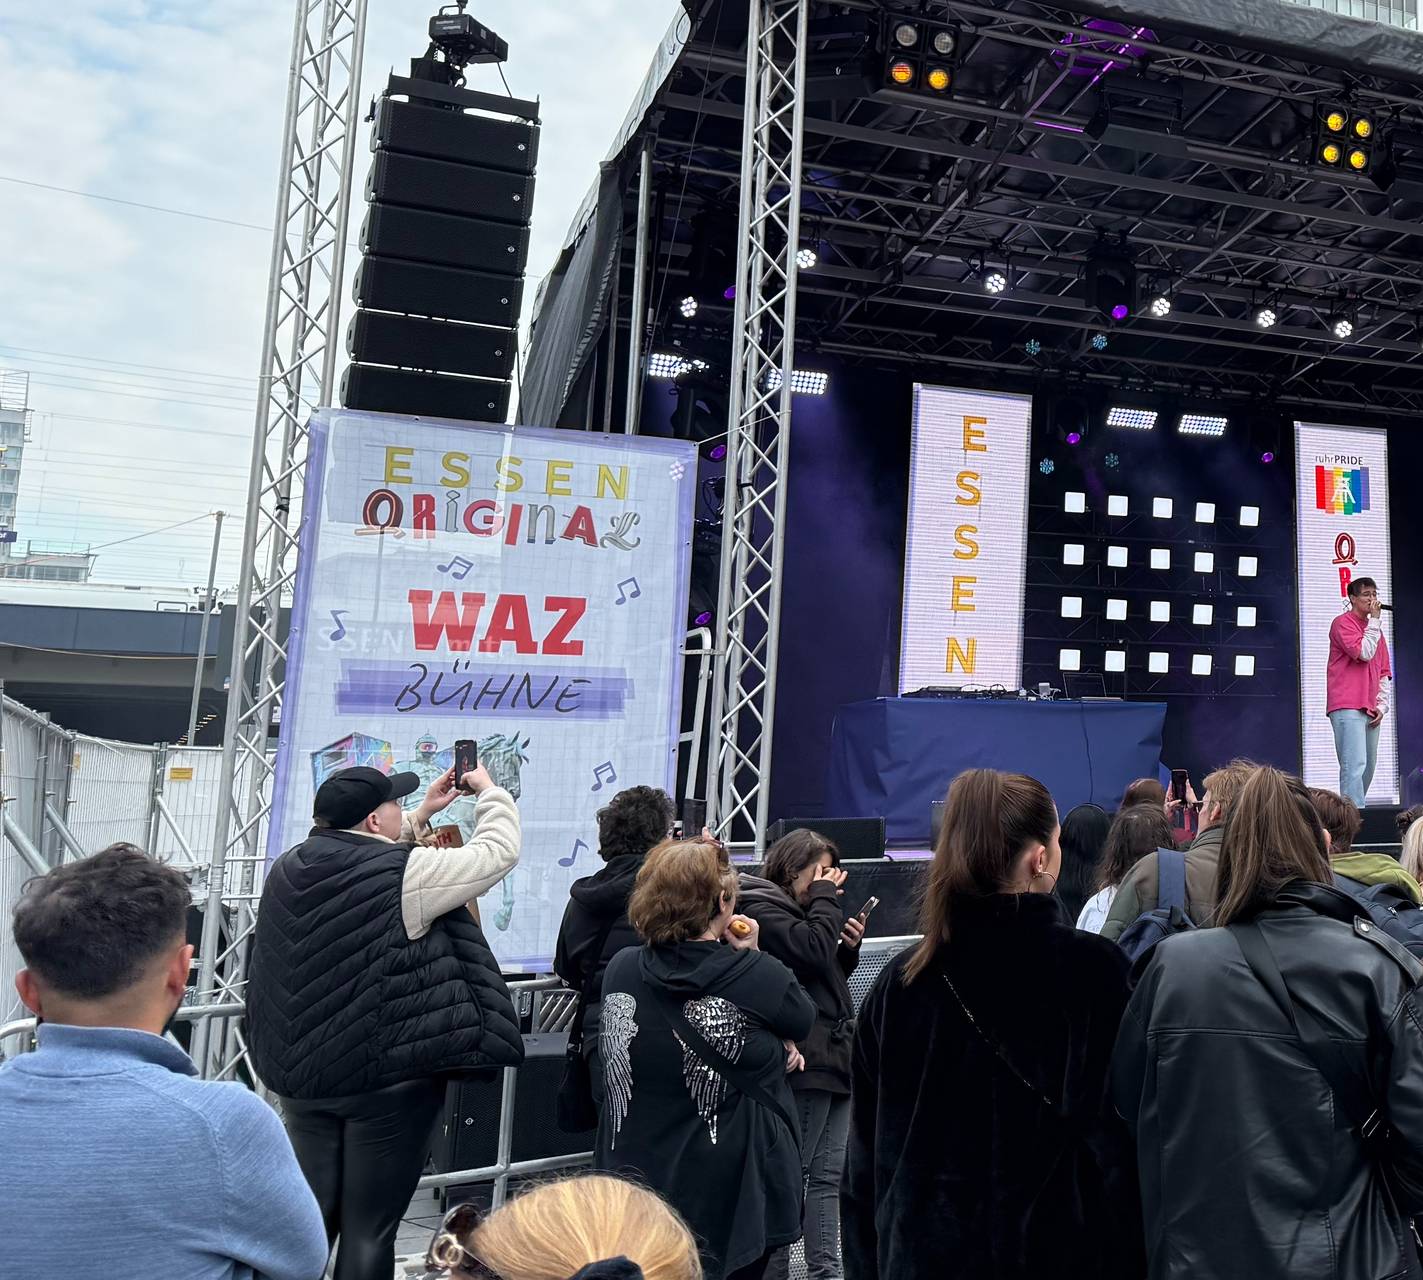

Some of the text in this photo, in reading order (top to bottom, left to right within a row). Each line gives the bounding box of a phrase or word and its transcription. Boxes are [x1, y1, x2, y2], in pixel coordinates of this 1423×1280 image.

[385, 446, 628, 500] ESSEN
[1315, 454, 1363, 466] ruhrPRIDE
[944, 415, 987, 673] ESSEN
[407, 588, 587, 657] WAZ
[394, 657, 591, 713] BÜHNE
